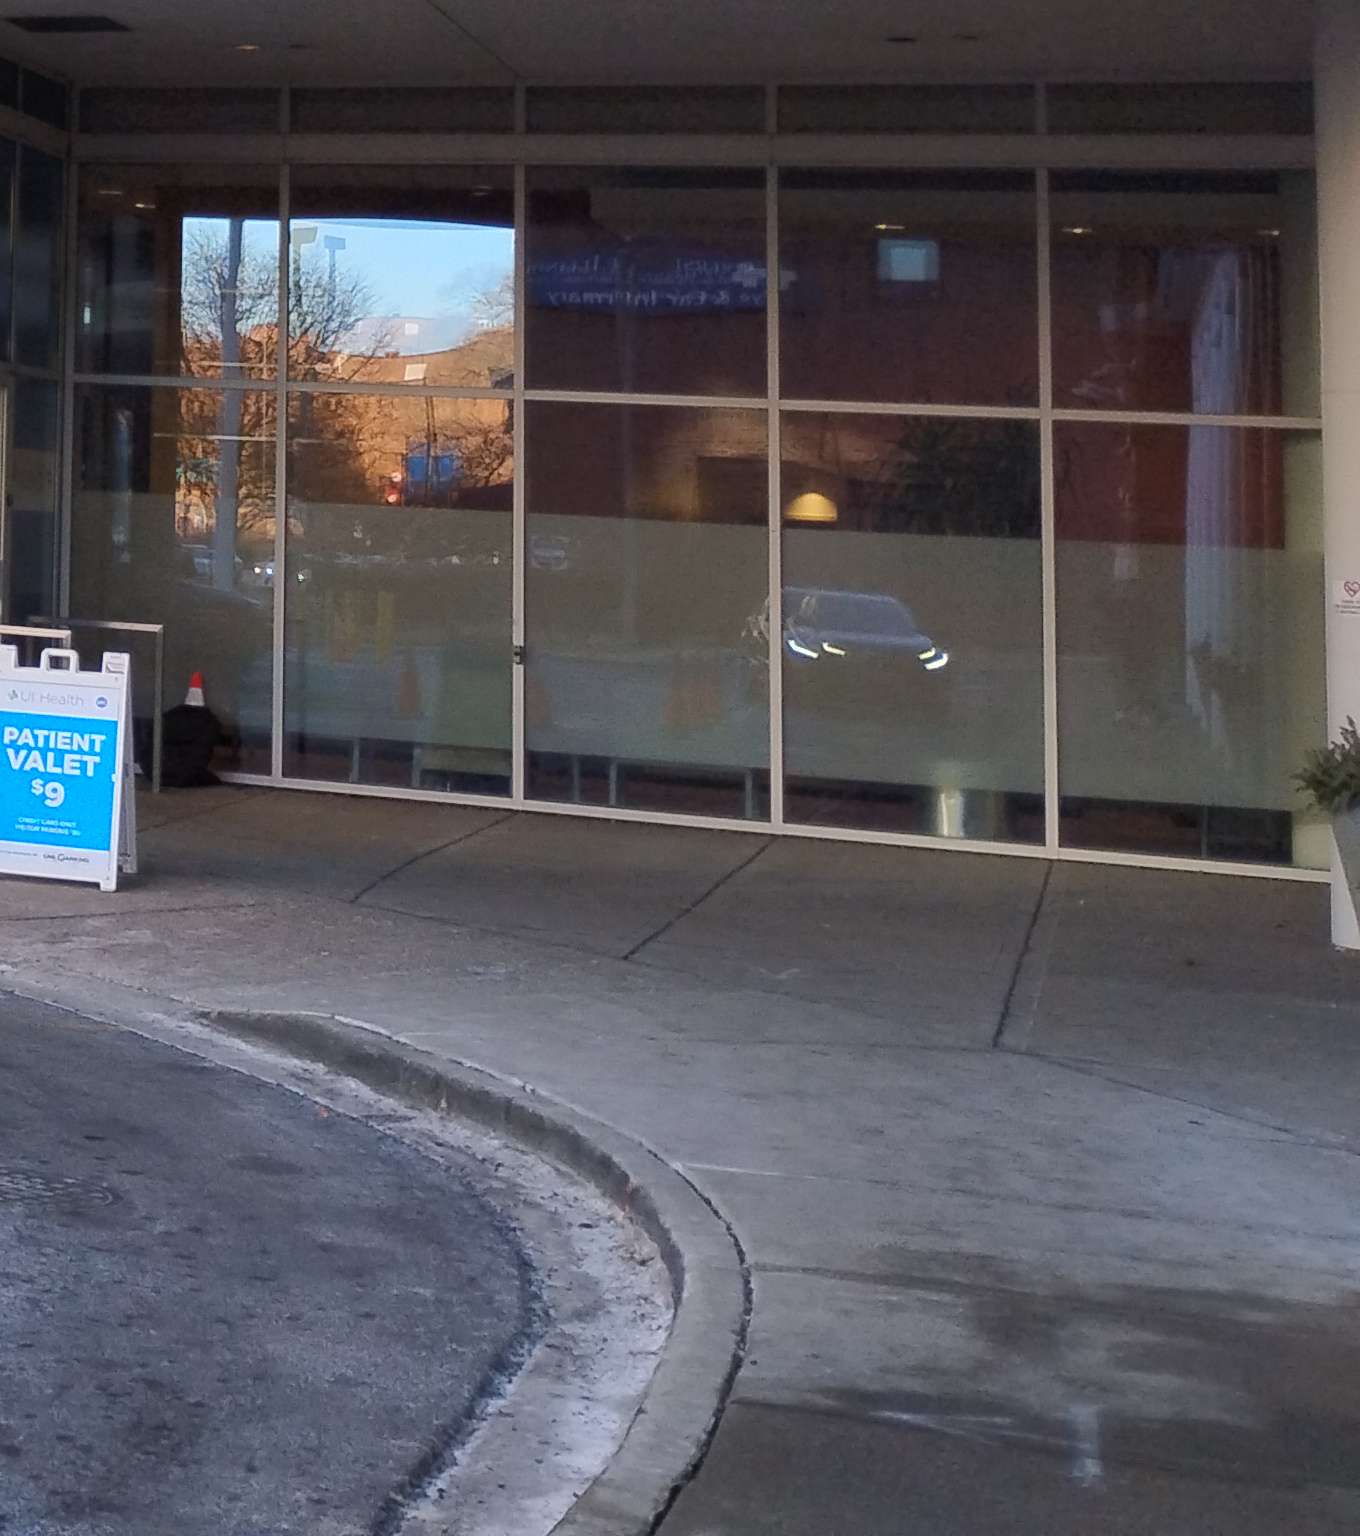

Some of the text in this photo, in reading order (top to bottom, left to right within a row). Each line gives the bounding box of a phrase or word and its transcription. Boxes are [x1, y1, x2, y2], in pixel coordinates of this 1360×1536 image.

[40, 692, 85, 706] Health
[3, 726, 107, 753] PATIENT
[6, 748, 101, 777] VALET
[31, 778, 65, 808] $9
